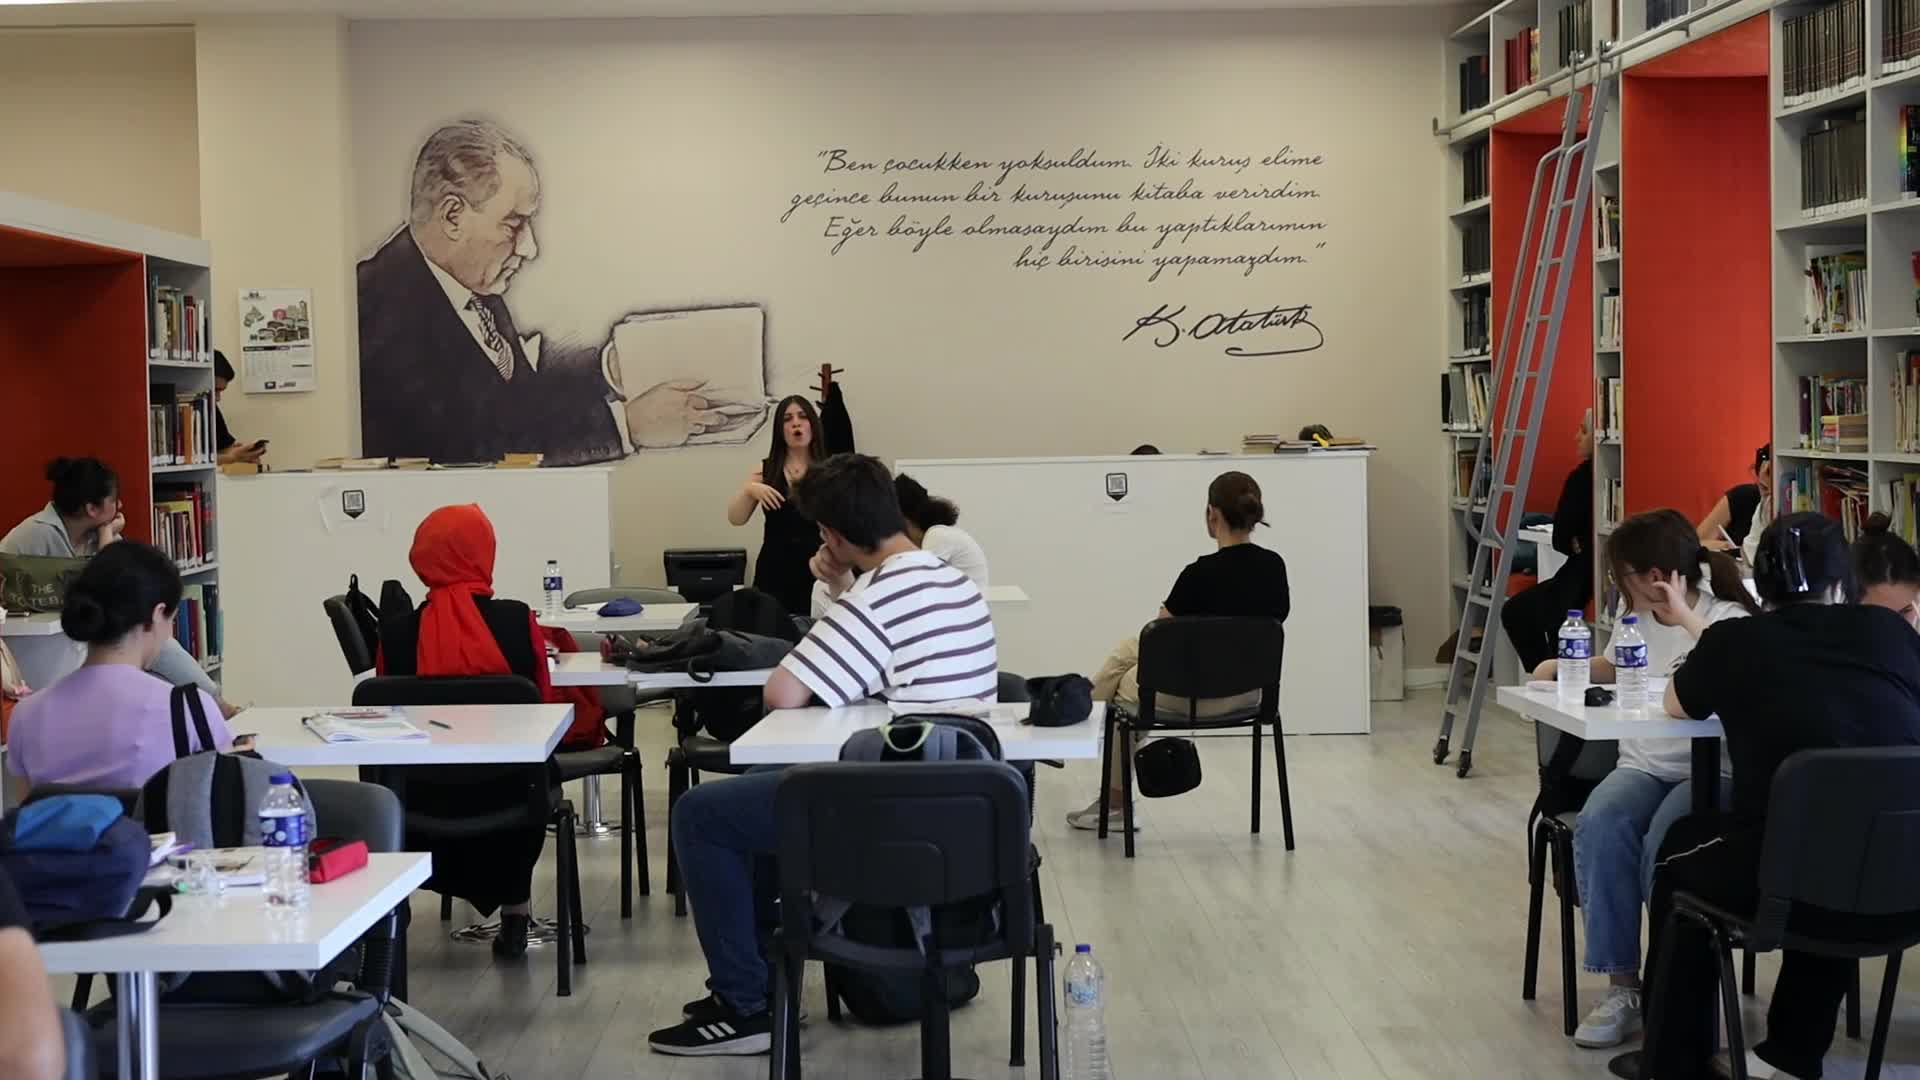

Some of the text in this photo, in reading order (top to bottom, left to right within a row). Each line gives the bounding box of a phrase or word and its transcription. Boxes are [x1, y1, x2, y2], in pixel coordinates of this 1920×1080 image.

[882, 151, 992, 174] çocukken
[994, 147, 1132, 186] yoksuldum.
[1143, 141, 1180, 168] İki
[1187, 148, 1251, 174] kuruş
[1261, 145, 1323, 166] elime
[780, 178, 1320, 223] geçince bunun bir kuruşunu kitaba verirdim.
[824, 211, 1328, 256] Eğer böyle olmasaydım bu yaptıklarımın
[1015, 245, 1050, 271] hiç
[1057, 245, 1147, 268] birisini
[31, 583, 56, 594] THE
